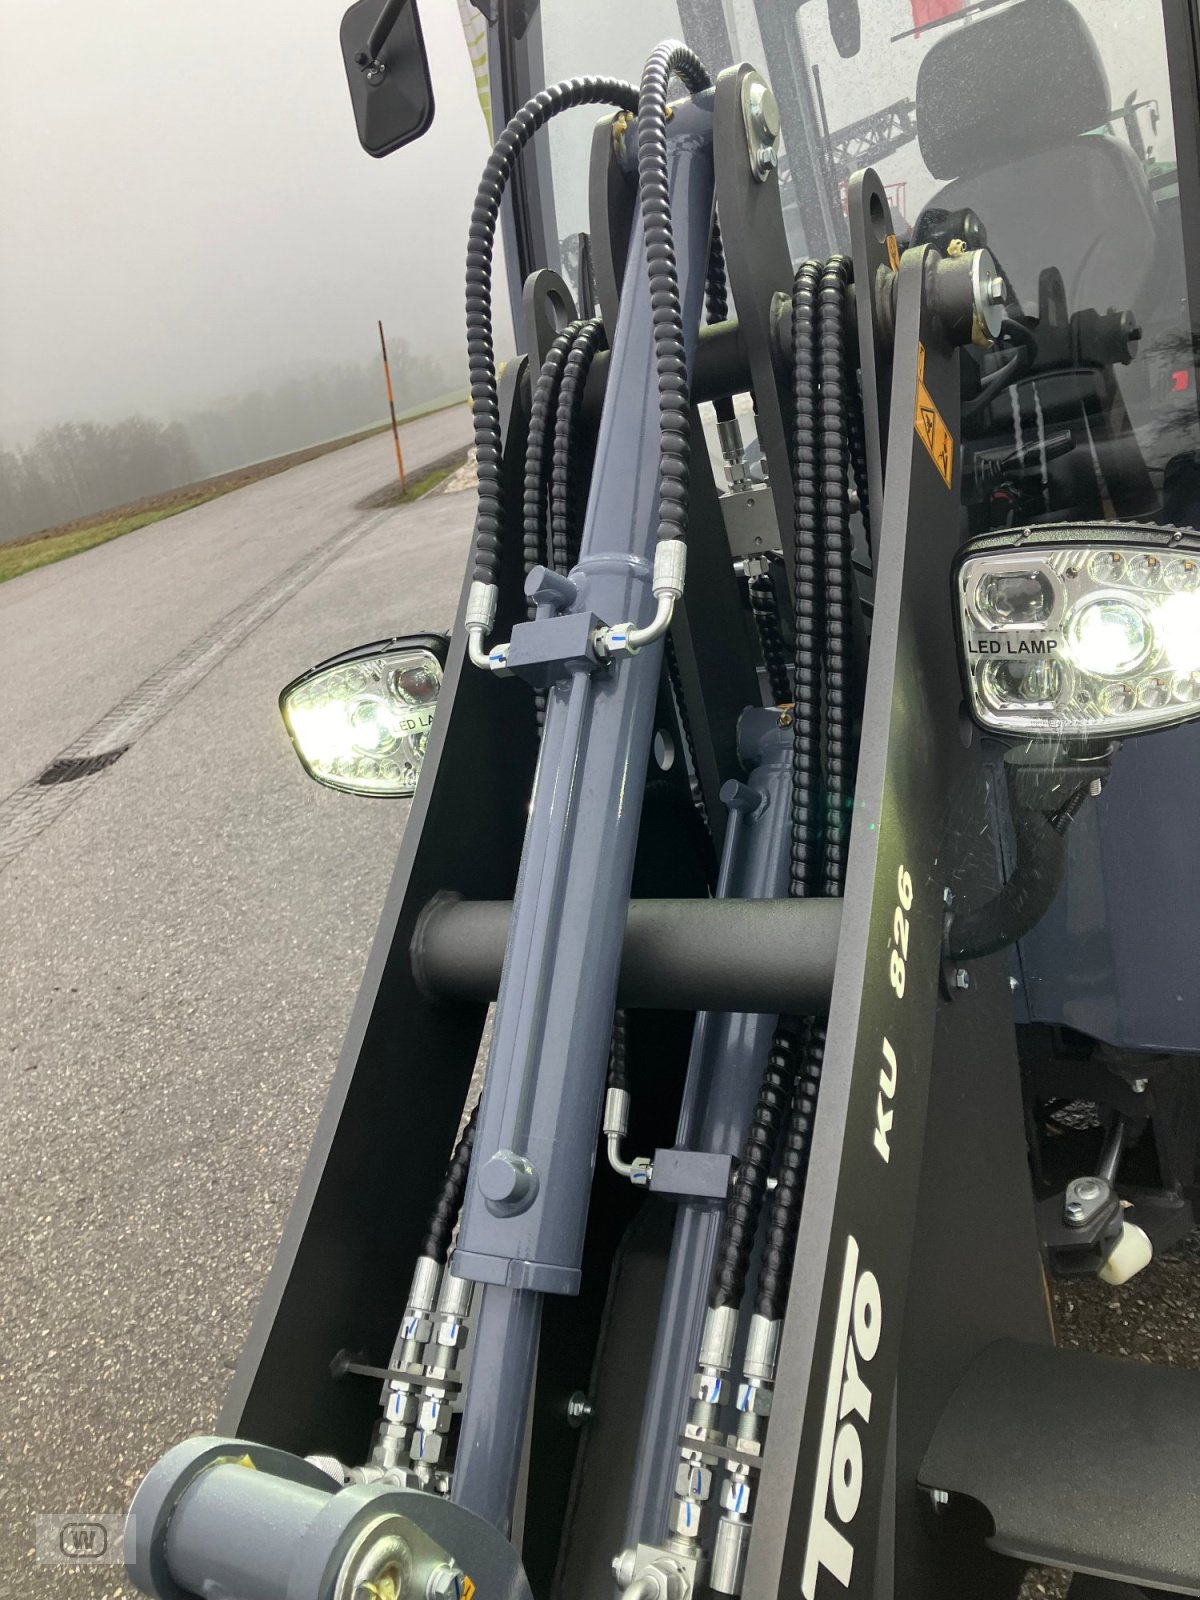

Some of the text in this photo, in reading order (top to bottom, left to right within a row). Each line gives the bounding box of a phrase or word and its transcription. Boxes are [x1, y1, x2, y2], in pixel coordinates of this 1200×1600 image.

[968, 640, 1058, 654] LED LAMP
[418, 714, 434, 727] LA
[873, 1036, 898, 1164] KU
[889, 864, 914, 999] 826
